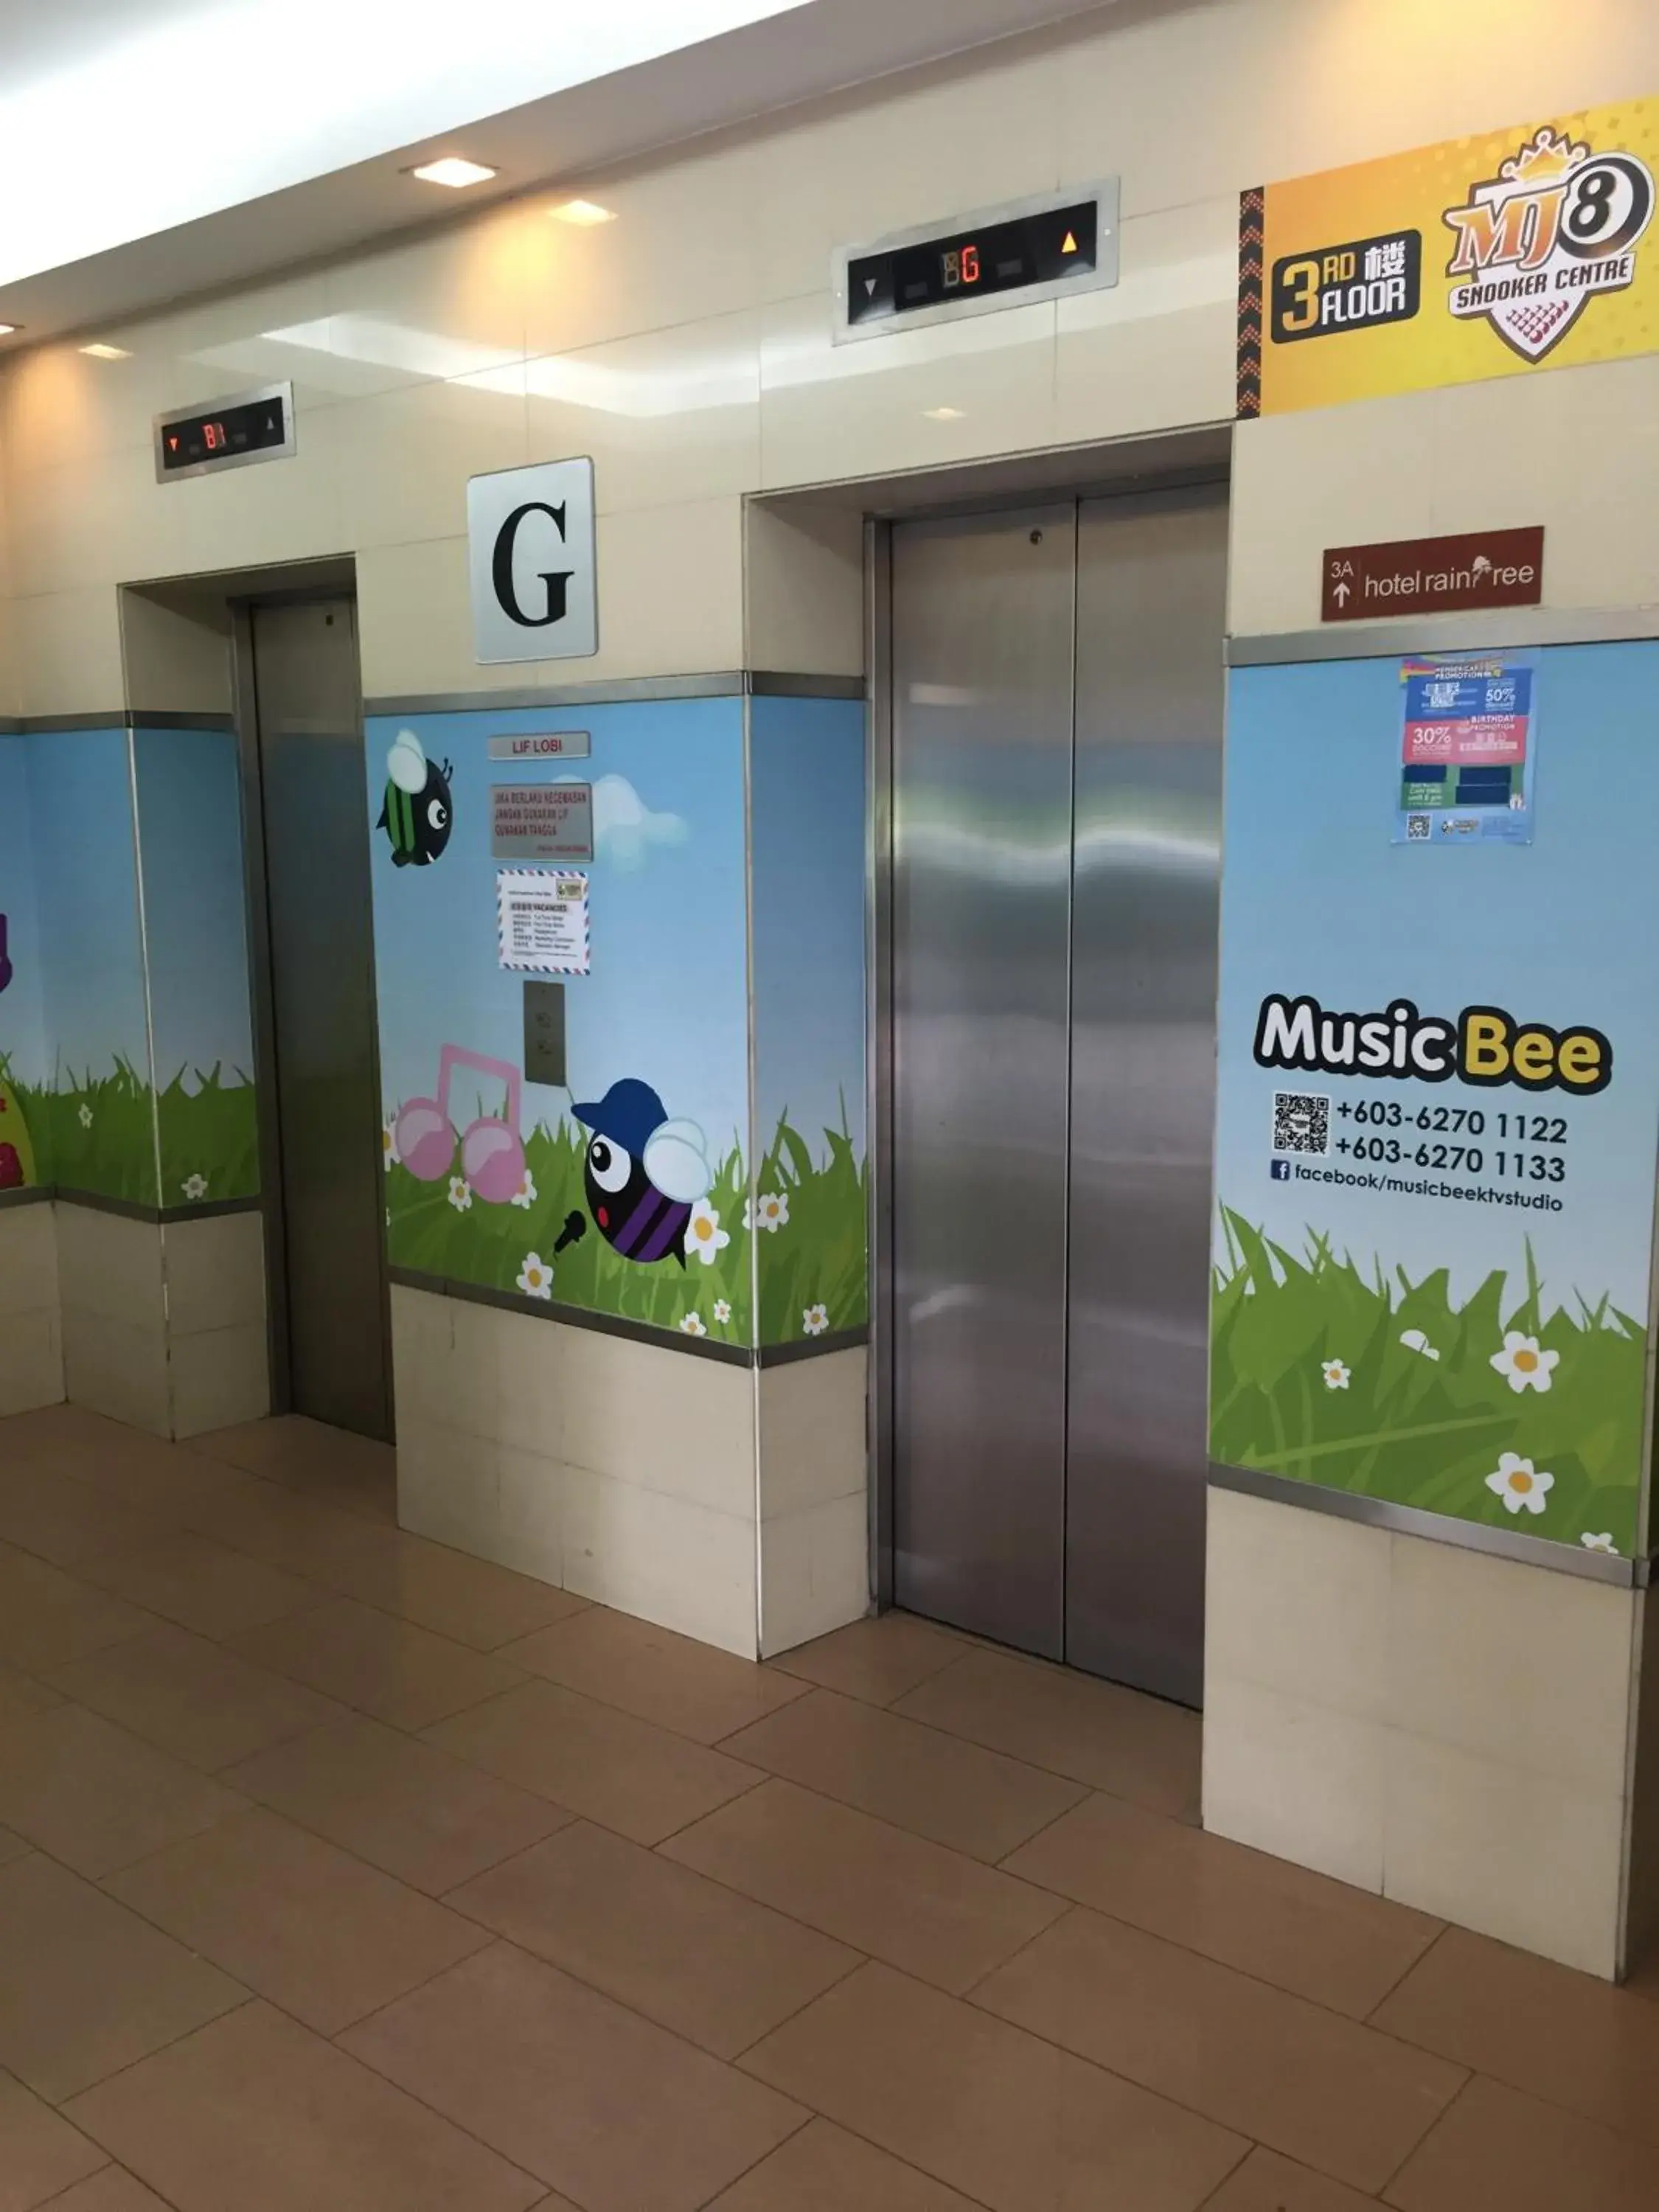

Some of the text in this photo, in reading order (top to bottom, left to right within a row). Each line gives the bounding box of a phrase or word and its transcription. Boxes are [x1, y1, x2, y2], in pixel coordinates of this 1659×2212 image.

[1364, 240, 1406, 281] 楼
[1321, 277, 1406, 325] FLOOR
[1456, 256, 1629, 308] SNOOKER CENTRE
[492, 498, 575, 627] G
[1330, 560, 1354, 579] 3A
[1365, 570, 1421, 598] hotel
[1485, 688, 1516, 702] 50%
[1413, 726, 1452, 744] 30%
[1471, 714, 1514, 723] BIRTHDAY
[512, 739, 563, 754] LIF LOBI
[1258, 998, 1607, 1089] Music Bee
[1336, 1100, 1568, 1144] +603-6270 1122
[1335, 1136, 1566, 1183] +603-6270 1133
[1295, 1164, 1564, 1212] facebook/musicbeektvstudio
